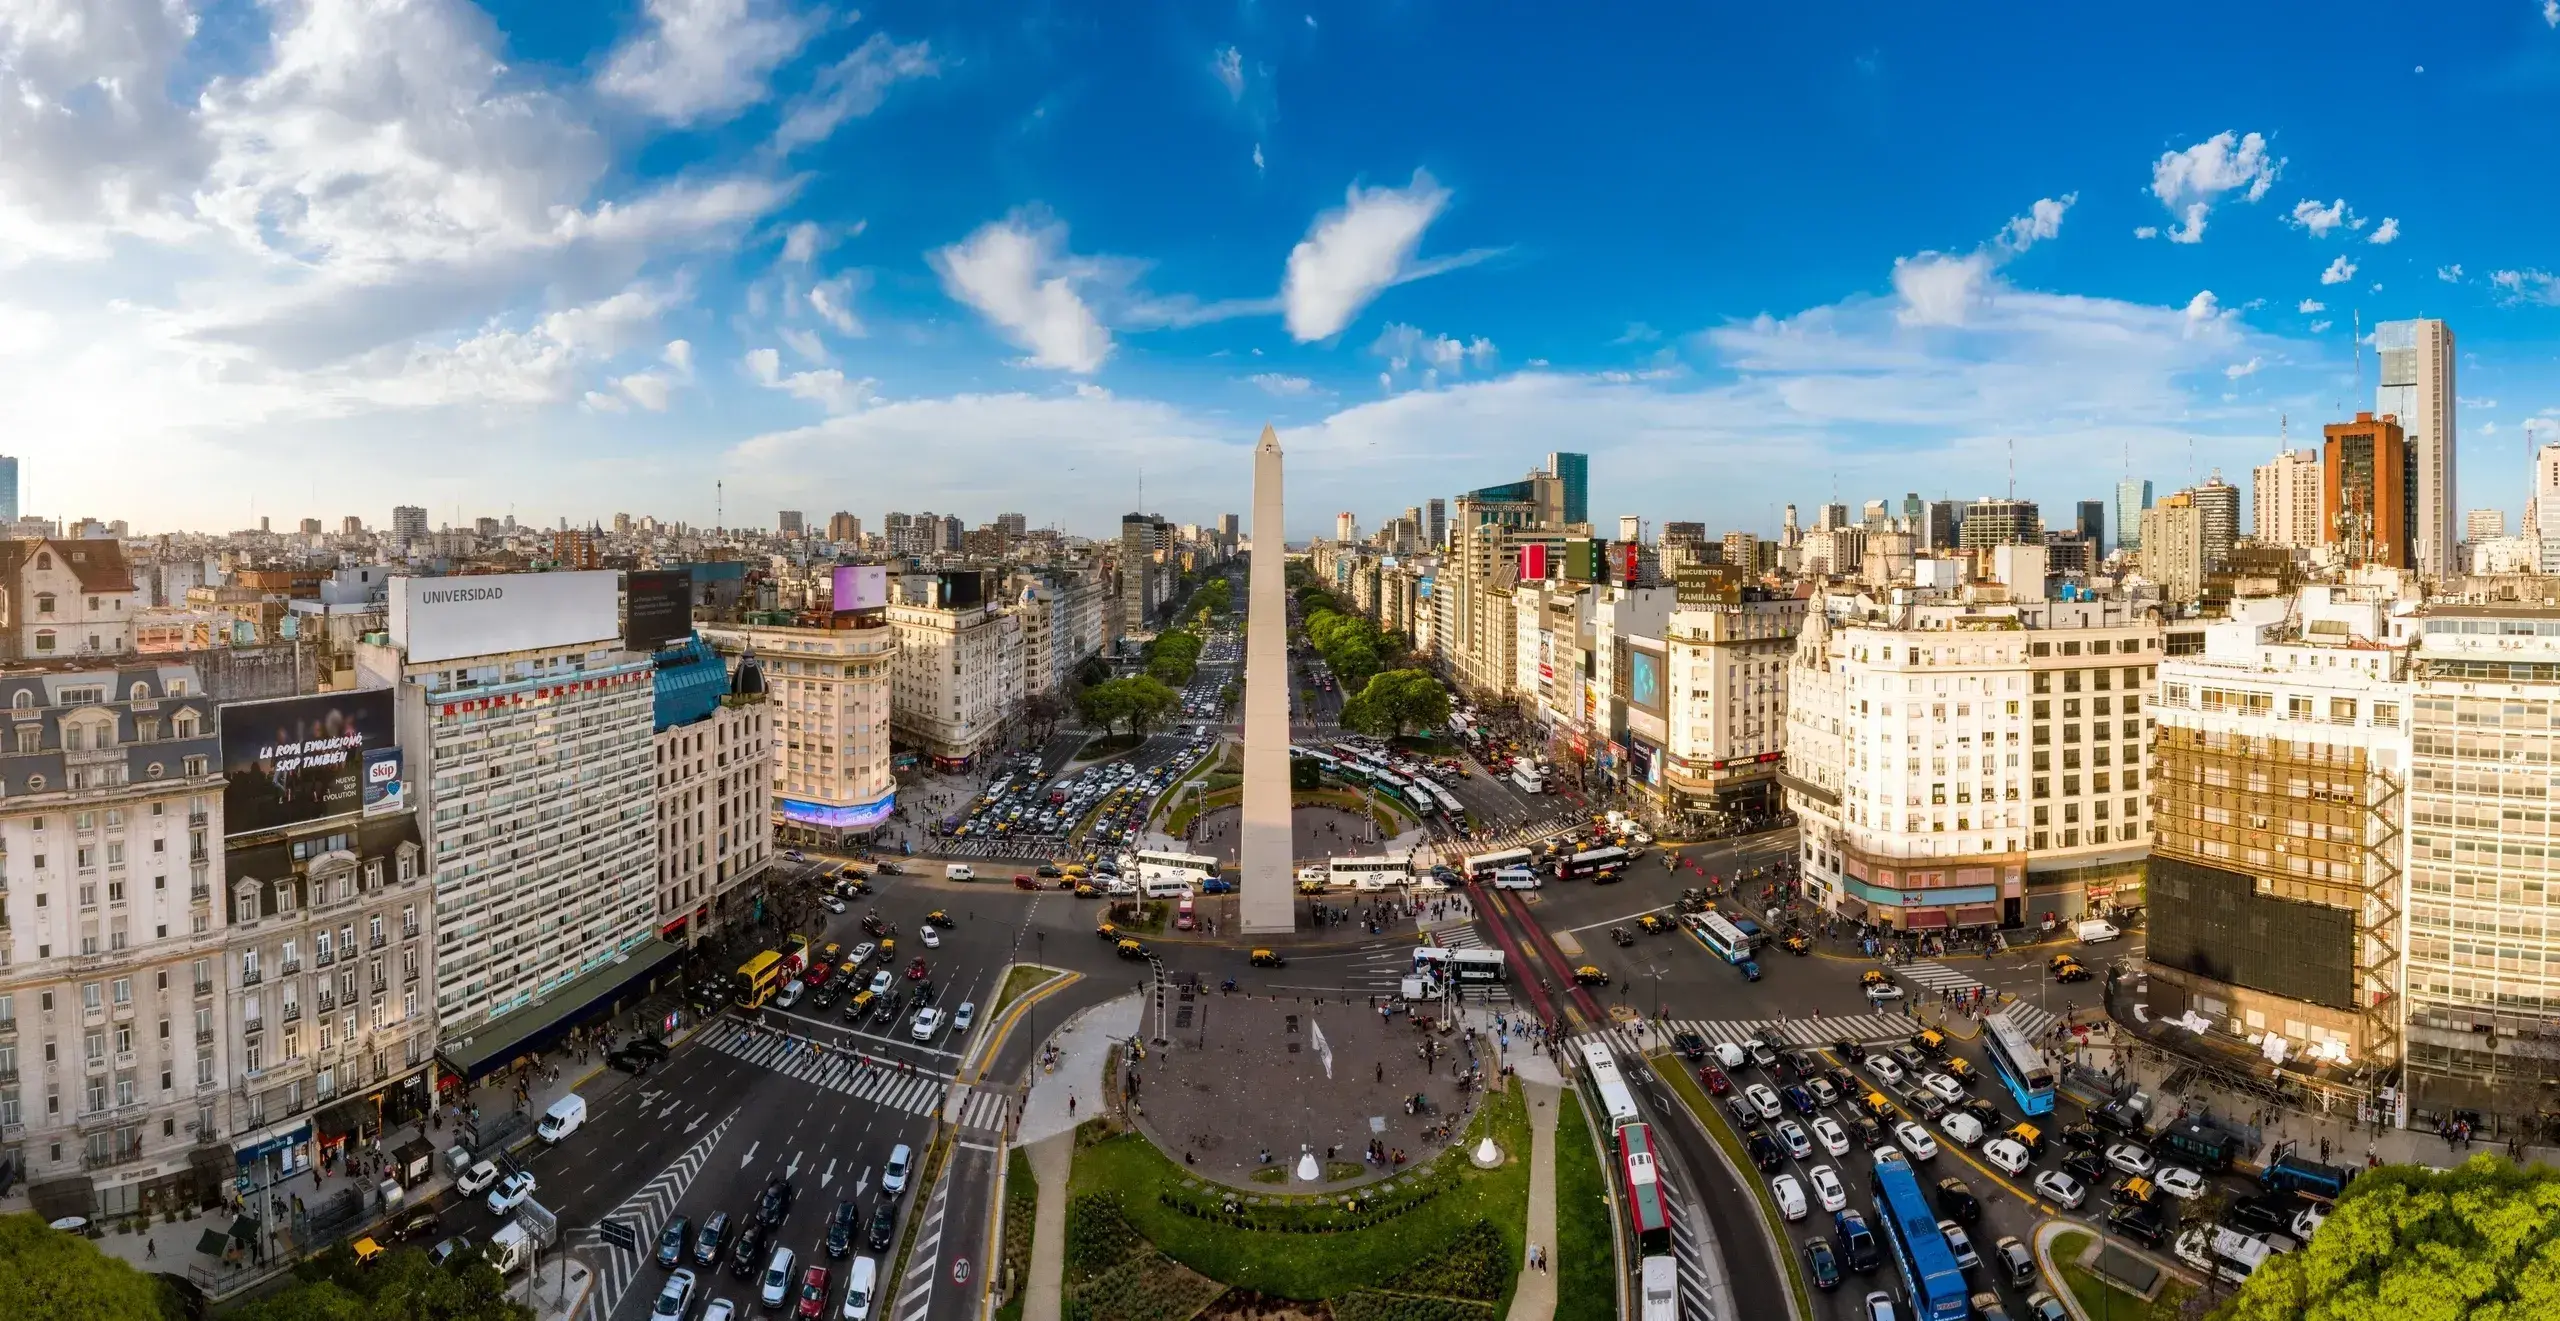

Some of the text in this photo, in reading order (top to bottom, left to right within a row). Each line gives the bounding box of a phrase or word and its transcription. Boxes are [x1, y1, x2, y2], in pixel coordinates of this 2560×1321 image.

[1469, 504, 1532, 512] PANAMERICANO
[423, 587, 503, 604] UNIVERSIDAD
[1678, 593, 1722, 601] FAMILIAS
[443, 670, 652, 716] HOTEL REPUBLICA
[259, 746, 273, 760] LA
[275, 741, 301, 757] ROPA
[276, 751, 348, 772] SKIP TAMBIÉN
[1728, 757, 1755, 767] ABOGADOS
[372, 764, 394, 778] skip
[335, 775, 356, 785] NUEVO
[343, 783, 357, 791] SKIP
[322, 790, 357, 802] EVOLUTION
[955, 1261, 969, 1279] 20
